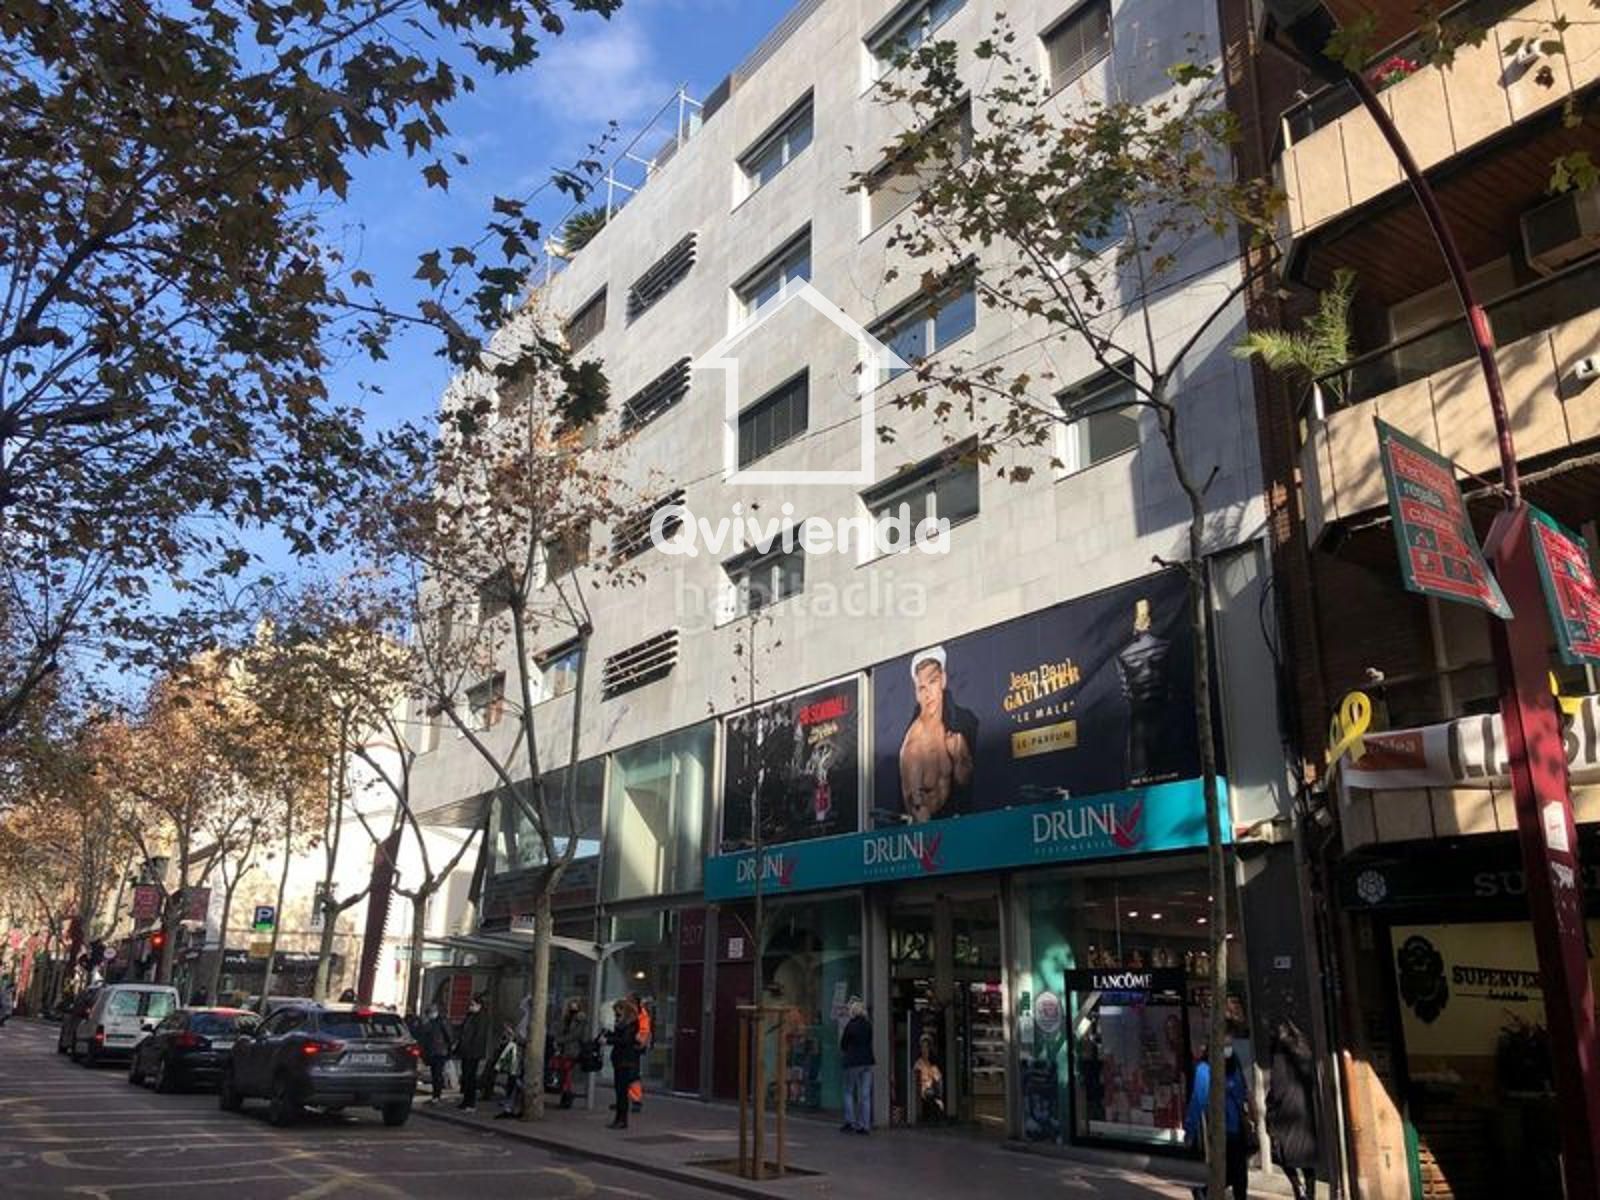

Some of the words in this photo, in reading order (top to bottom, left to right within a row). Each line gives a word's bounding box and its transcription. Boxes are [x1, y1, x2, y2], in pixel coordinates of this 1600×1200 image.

[1032, 802, 1117, 843] DRUNI
[863, 831, 924, 865] DRUNI
[1093, 971, 1153, 989] LANCÔME
